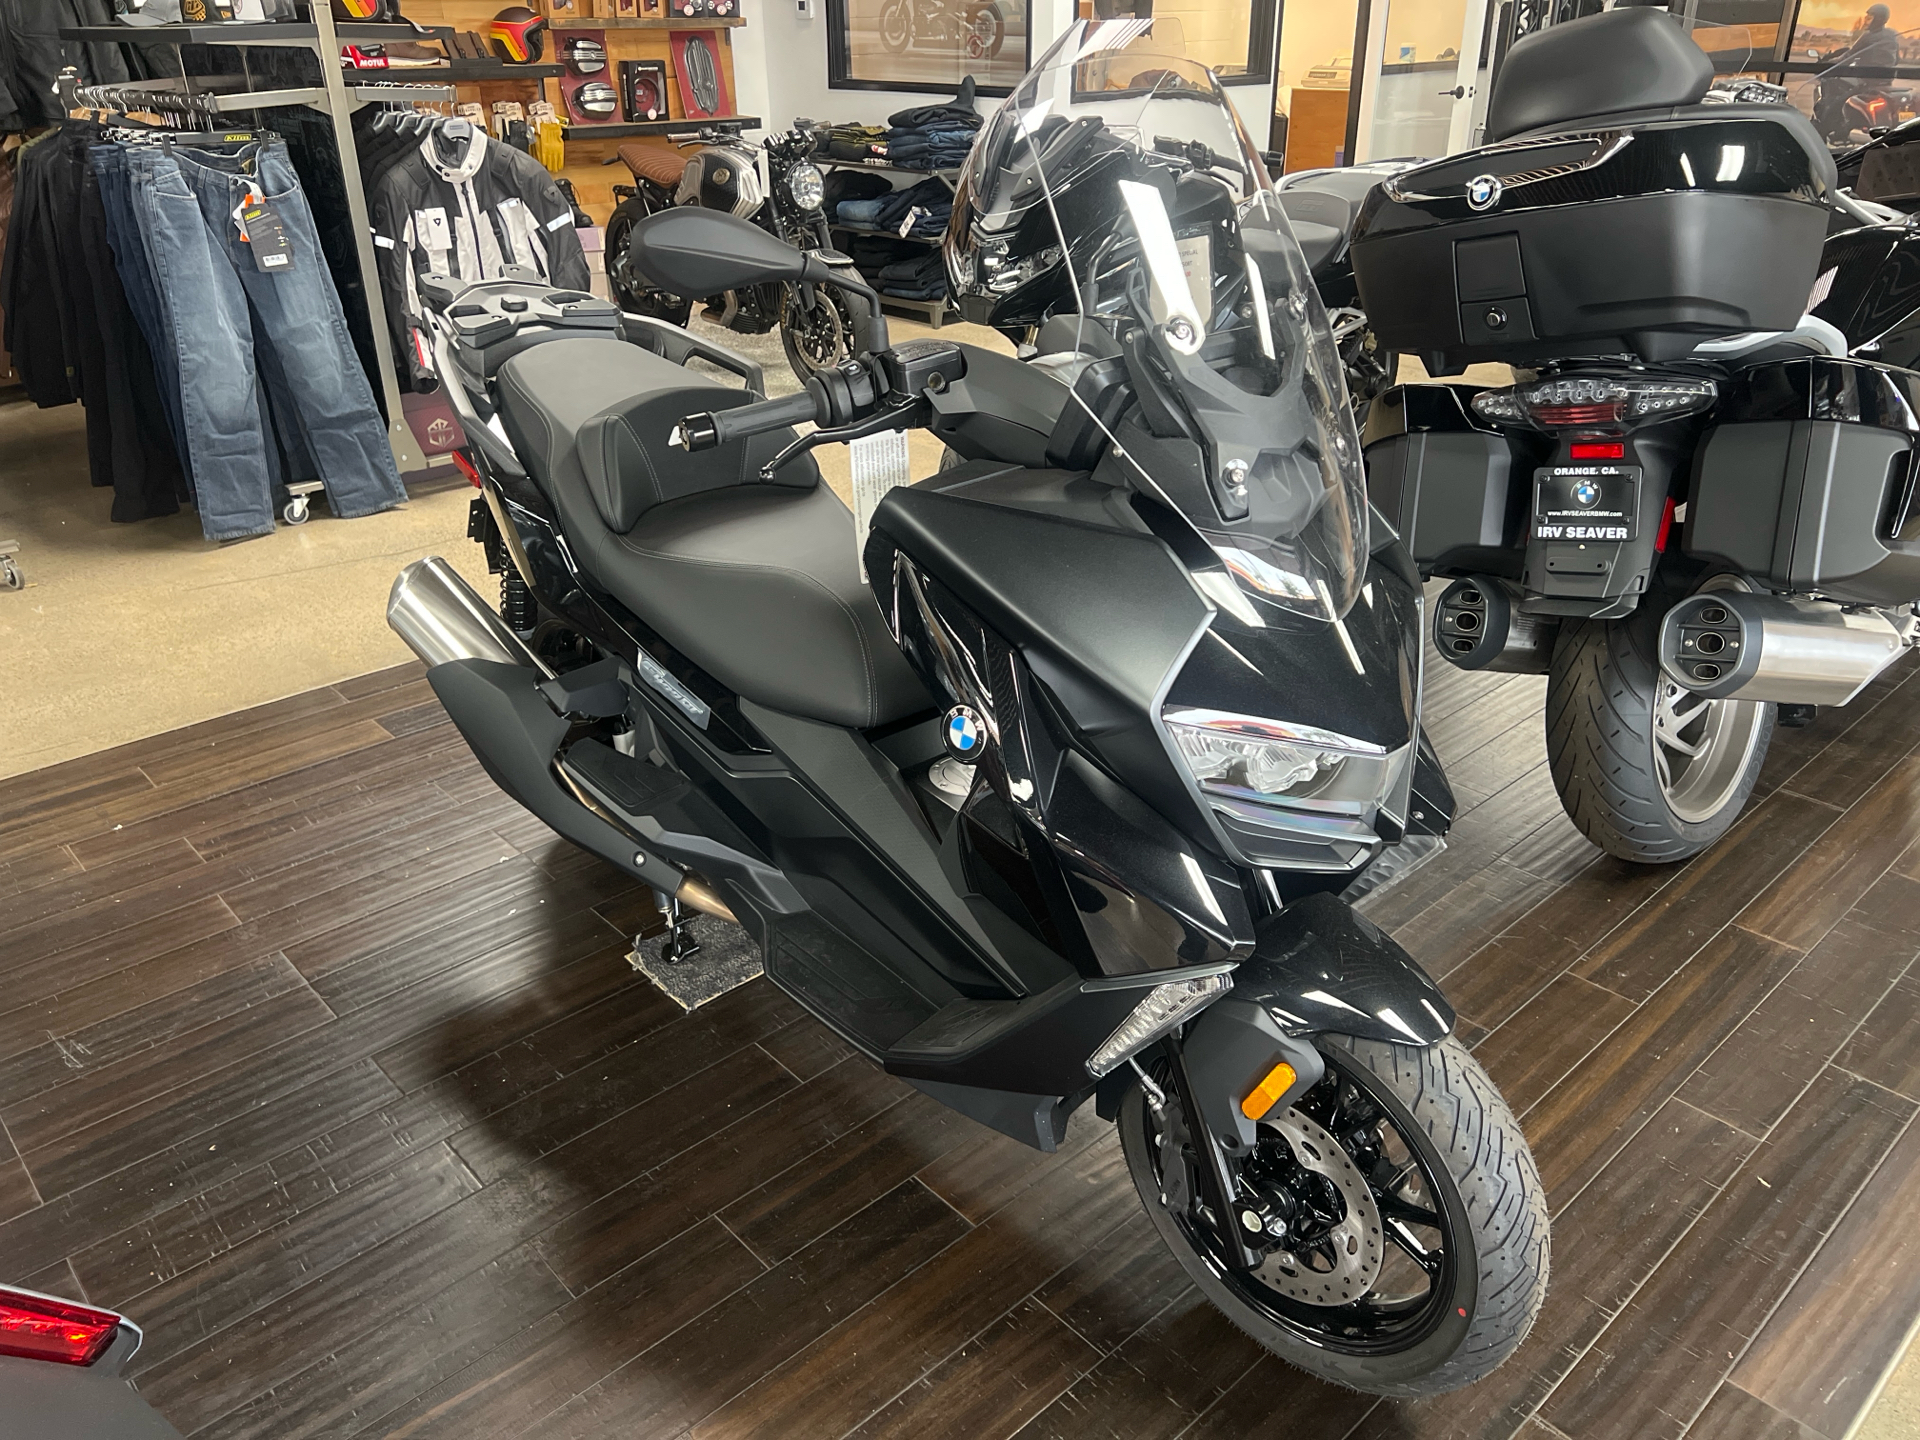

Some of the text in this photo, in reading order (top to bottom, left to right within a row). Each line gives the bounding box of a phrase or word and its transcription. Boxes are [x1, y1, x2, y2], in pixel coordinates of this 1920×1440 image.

[360, 58, 386, 67] MOTUL
[1601, 467, 1619, 475] CA.
[1538, 527, 1627, 539] IRV SEAVER
